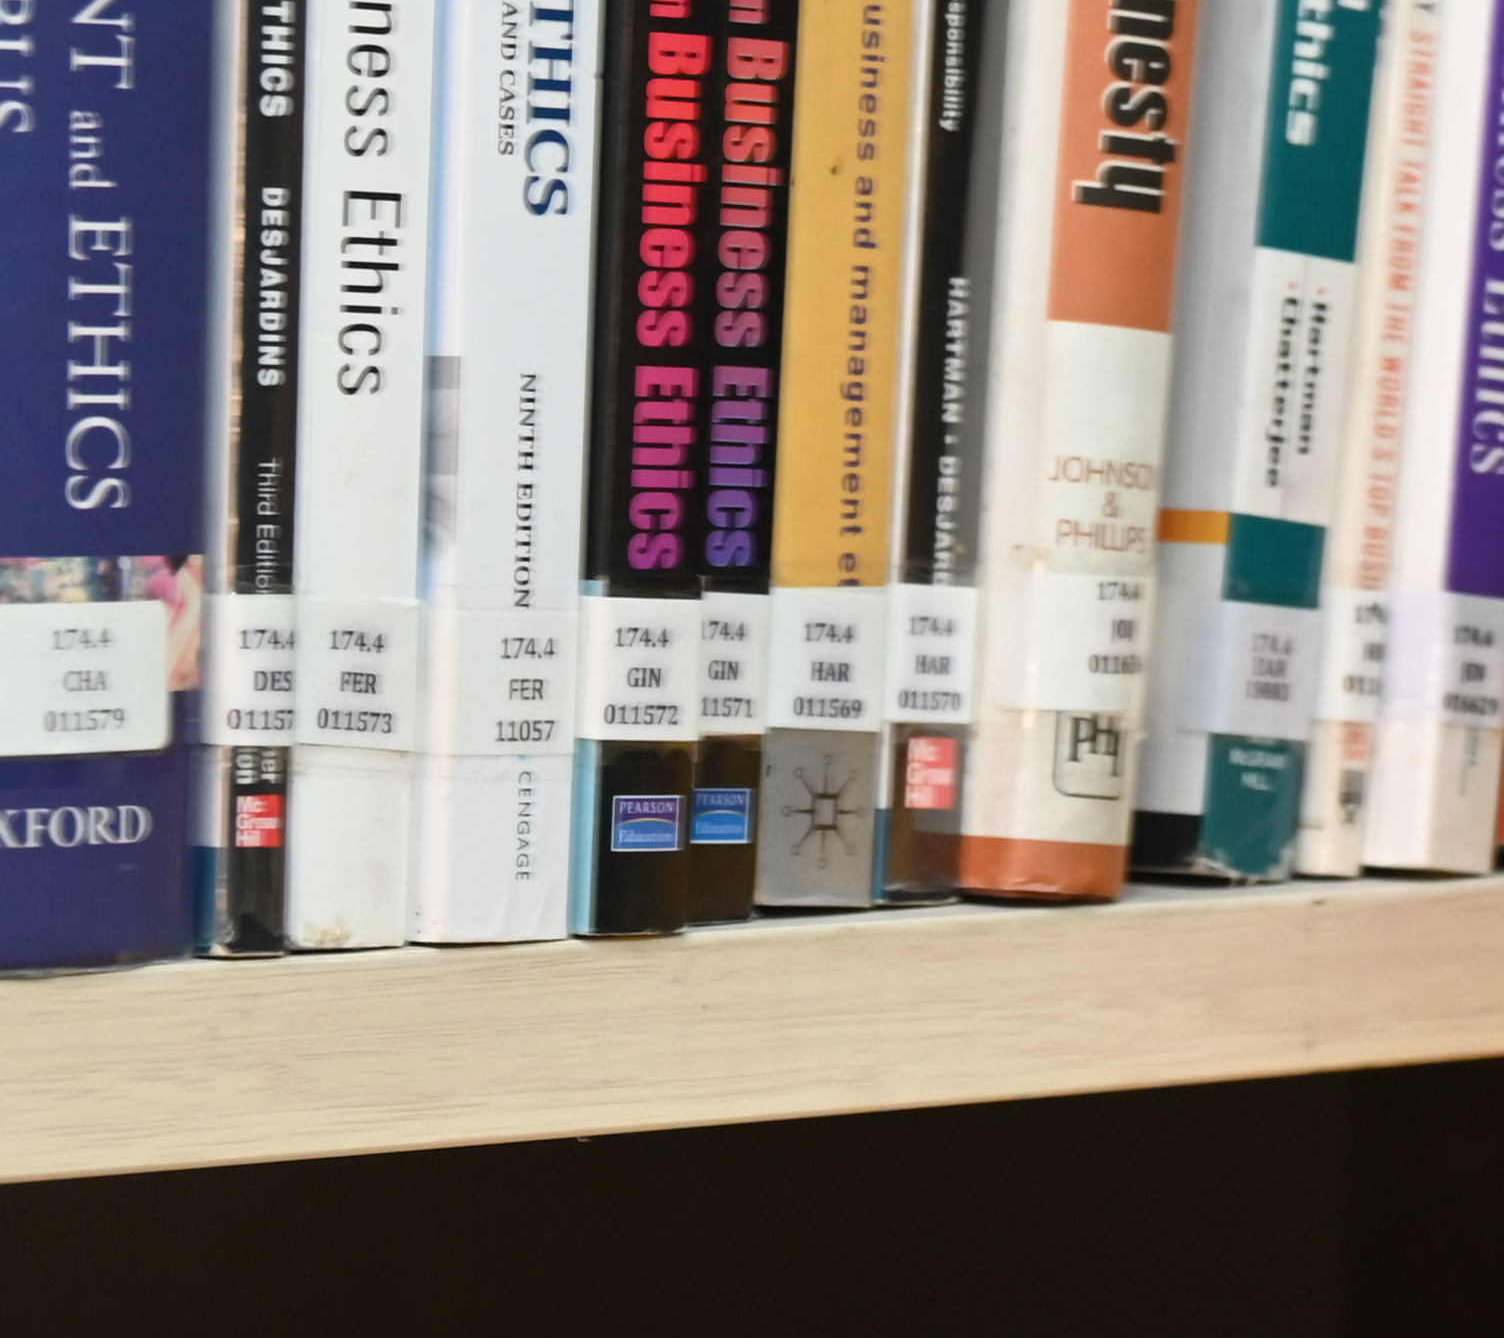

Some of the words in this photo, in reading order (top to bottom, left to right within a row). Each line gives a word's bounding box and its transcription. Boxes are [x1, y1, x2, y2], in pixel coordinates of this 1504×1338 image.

[499, 1, 517, 61] AND
[1400, 30, 1437, 149] STRAIGHT
[497, 68, 515, 157] CASES
[68, 110, 119, 189] and
[634, 31, 714, 350] Business
[713, 36, 790, 348] Business
[849, 175, 878, 251] and
[257, 186, 291, 389] DESJARDINS
[336, 188, 404, 398] Ethics
[64, 213, 134, 511] ETHICS
[941, 276, 972, 424] HARTMAN
[837, 263, 872, 528] management
[516, 372, 539, 471] NINTH
[626, 364, 700, 570] Ethics
[704, 364, 773, 568] Ethics
[256, 457, 283, 517] Third
[513, 481, 534, 609] EDITION
[613, 627, 671, 649] 174.4
[804, 623, 855, 643] 174.4
[909, 616, 956, 637] 174.4
[52, 629, 113, 651] 174.4
[328, 630, 386, 653] 174.4
[500, 637, 556, 661] 174.4
[707, 660, 741, 682] GIN
[811, 661, 852, 682] HAR
[915, 655, 952, 675] HAR
[63, 670, 108, 693] CHA
[340, 671, 378, 695] FER
[626, 667, 664, 688] GIN
[508, 679, 545, 702] FER
[603, 703, 679, 727] 011572
[793, 697, 863, 719] 011569
[43, 708, 127, 733] 011579
[316, 710, 395, 734] 011573
[495, 720, 557, 744] 11057
[618, 799, 676, 815] PEARSON
[696, 793, 747, 809] PEARSON
[514, 770, 533, 882] CENGAGE
